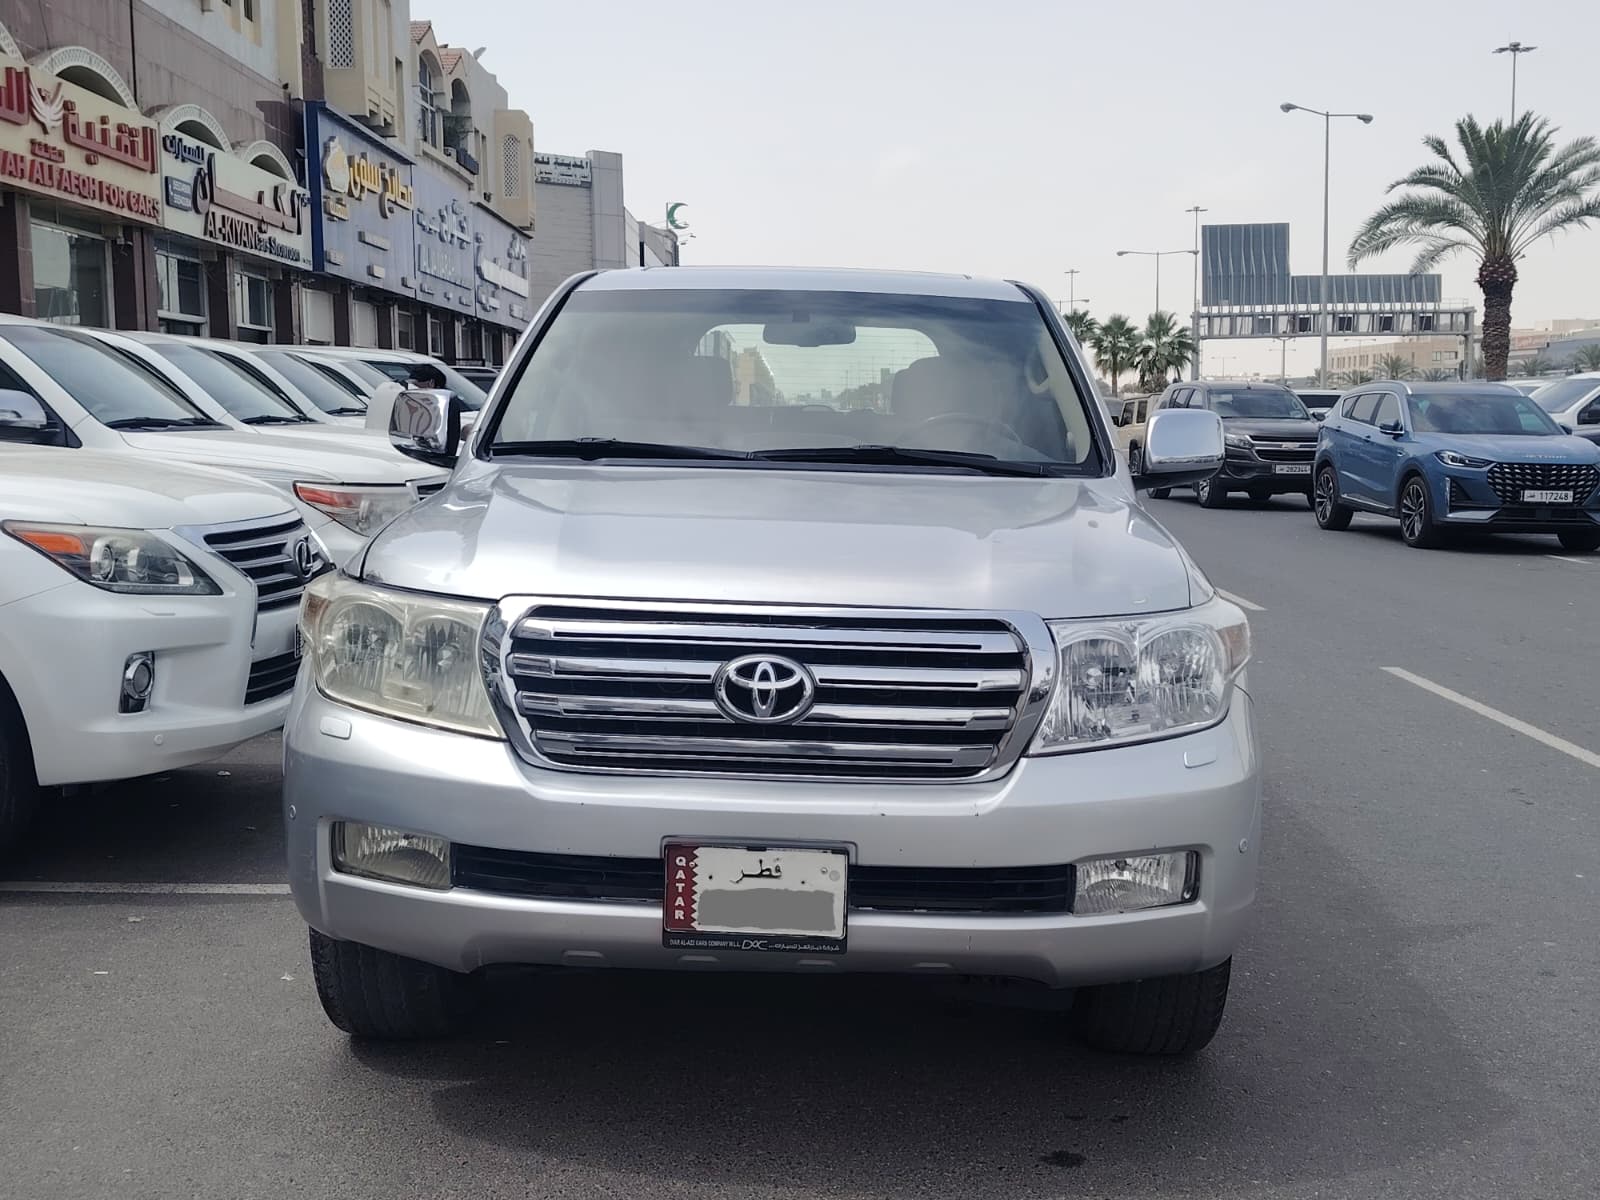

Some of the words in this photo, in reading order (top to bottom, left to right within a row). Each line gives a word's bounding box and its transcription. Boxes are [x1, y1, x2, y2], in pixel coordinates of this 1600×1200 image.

[63, 101, 158, 174] التقنية
[0, 149, 25, 179] AH
[29, 159, 54, 187] AL
[99, 180, 126, 208] FOR
[127, 189, 161, 222] CARS
[1540, 491, 1569, 501] 117248
[674, 856, 687, 920] QATAR
[730, 858, 783, 884] قطر
